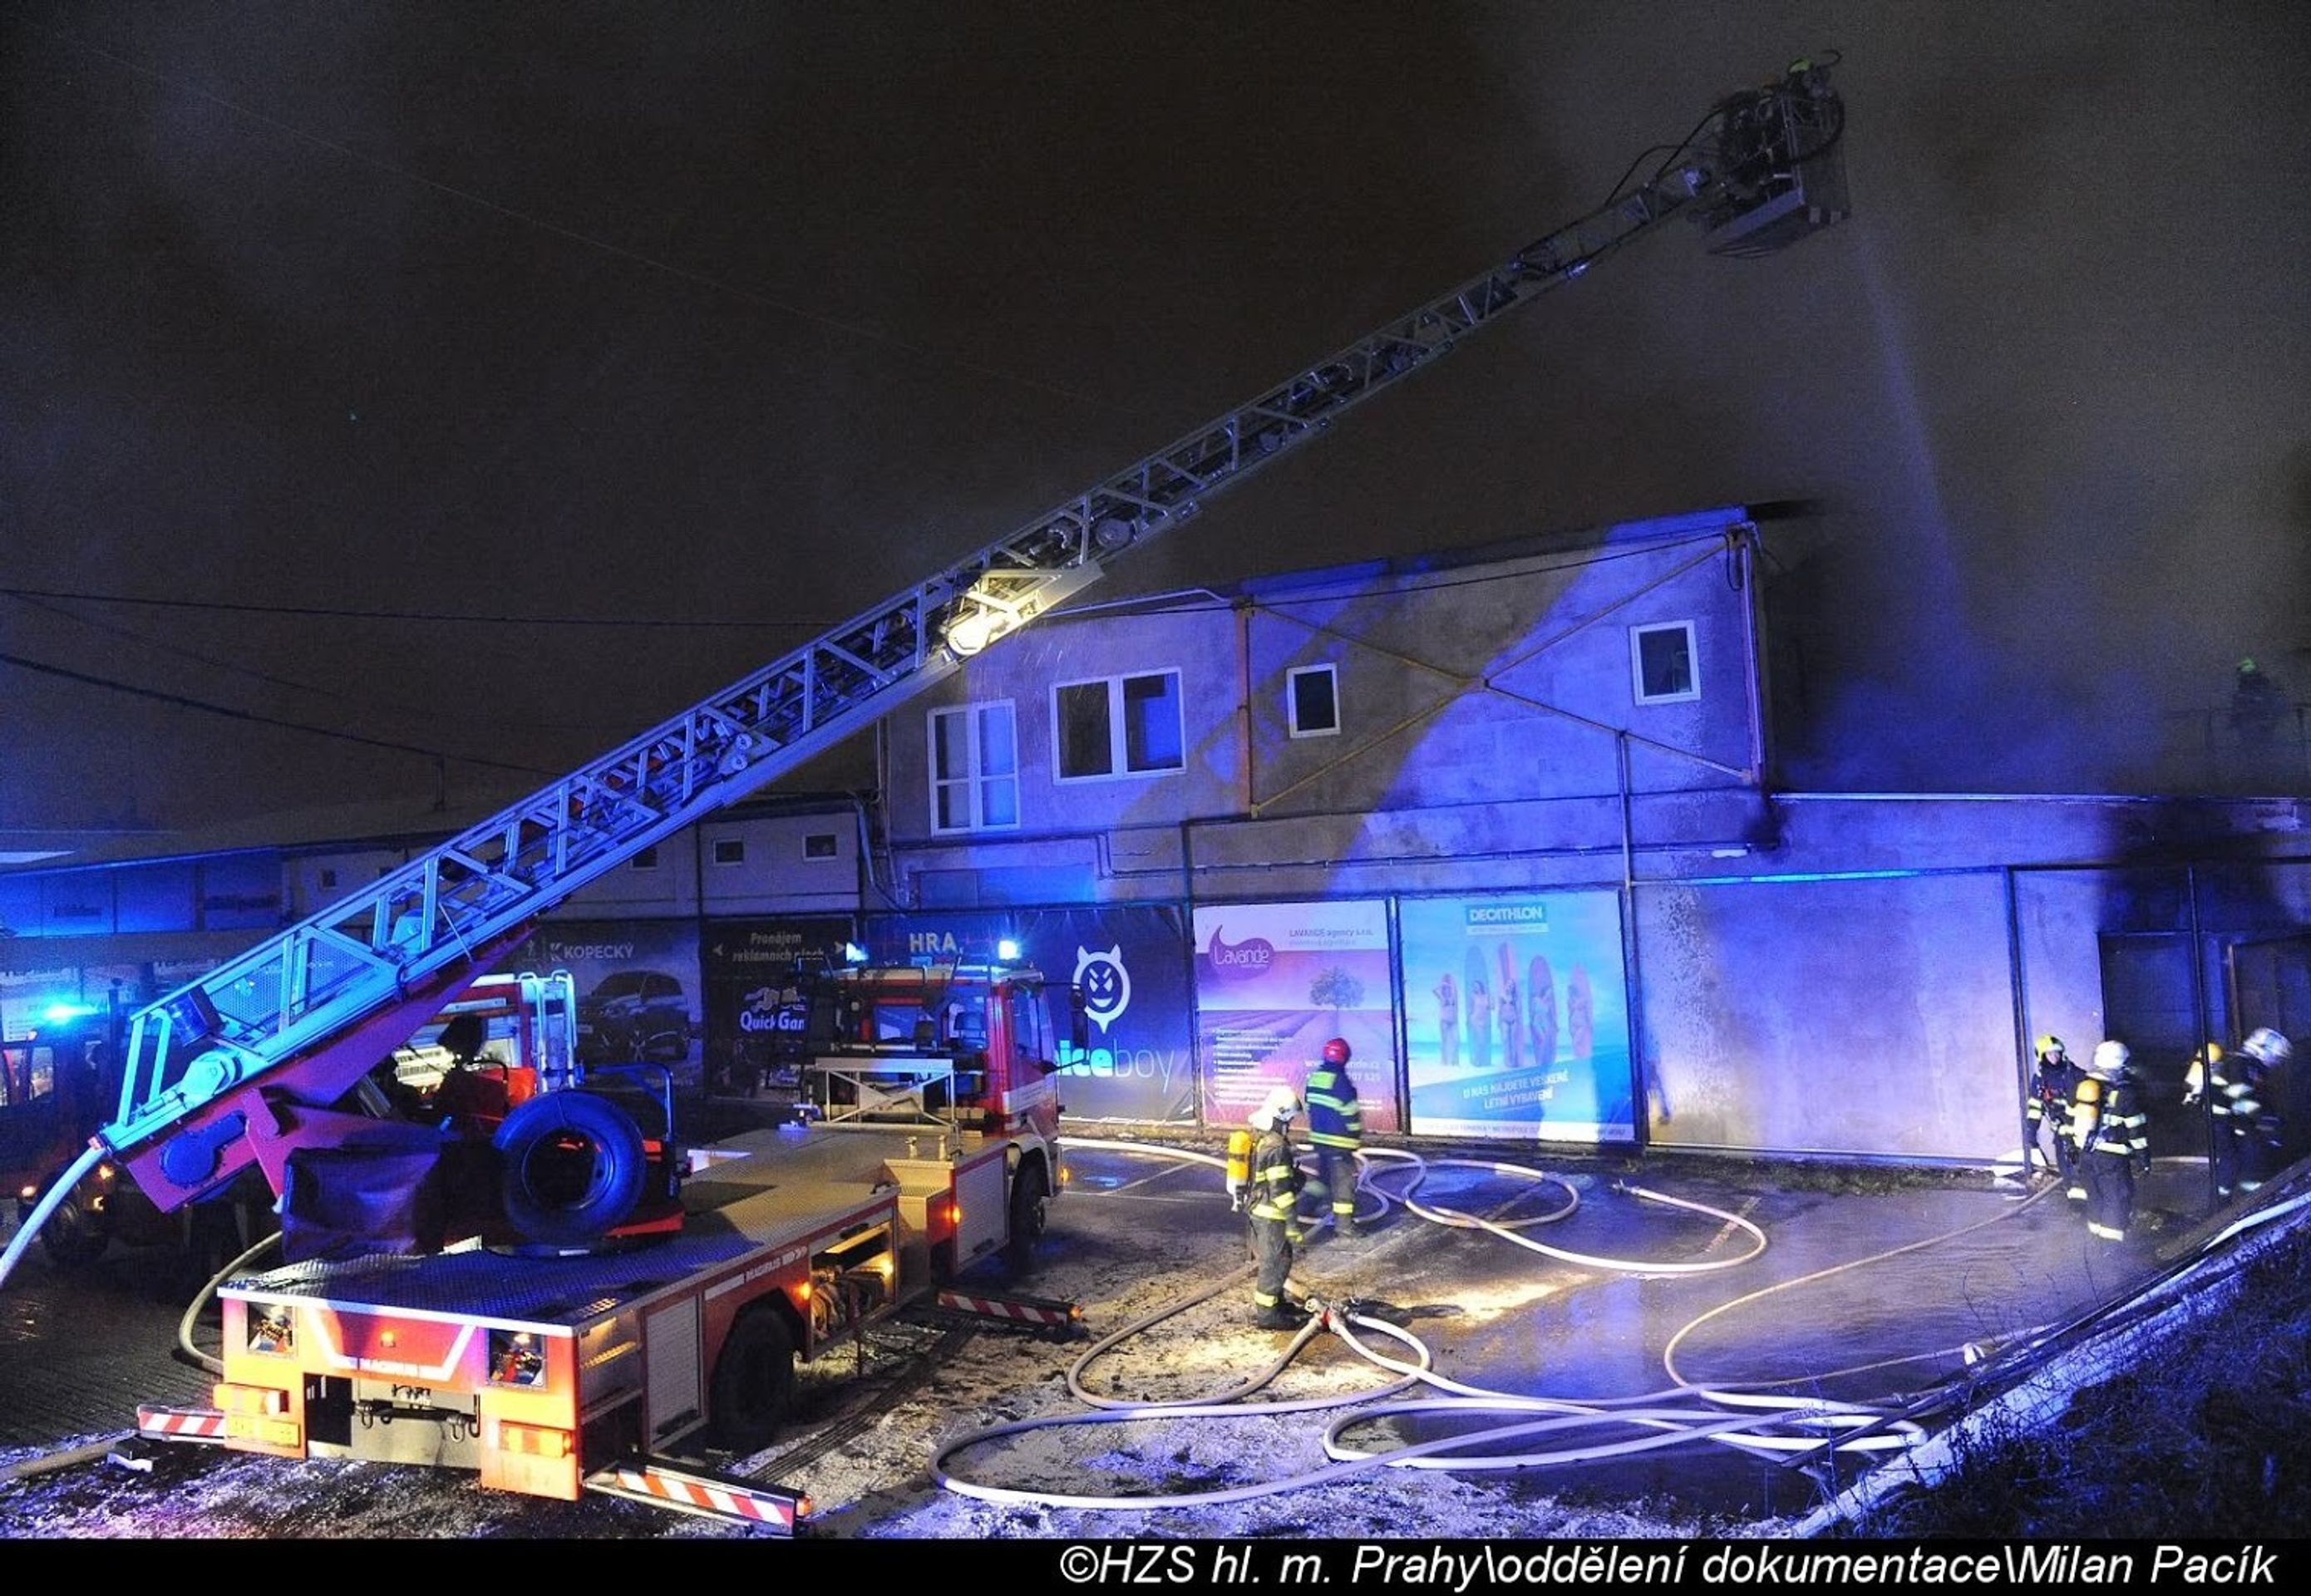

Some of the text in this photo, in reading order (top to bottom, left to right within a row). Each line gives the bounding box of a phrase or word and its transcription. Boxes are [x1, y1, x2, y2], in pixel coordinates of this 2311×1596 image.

[1469, 905, 1543, 922] DECATHLON
[564, 942, 634, 959] KOPECKÝ
[1214, 943, 1269, 965] Lavande
[740, 1010, 776, 1032] Quick
[1053, 1038, 1175, 1094] iceboy
